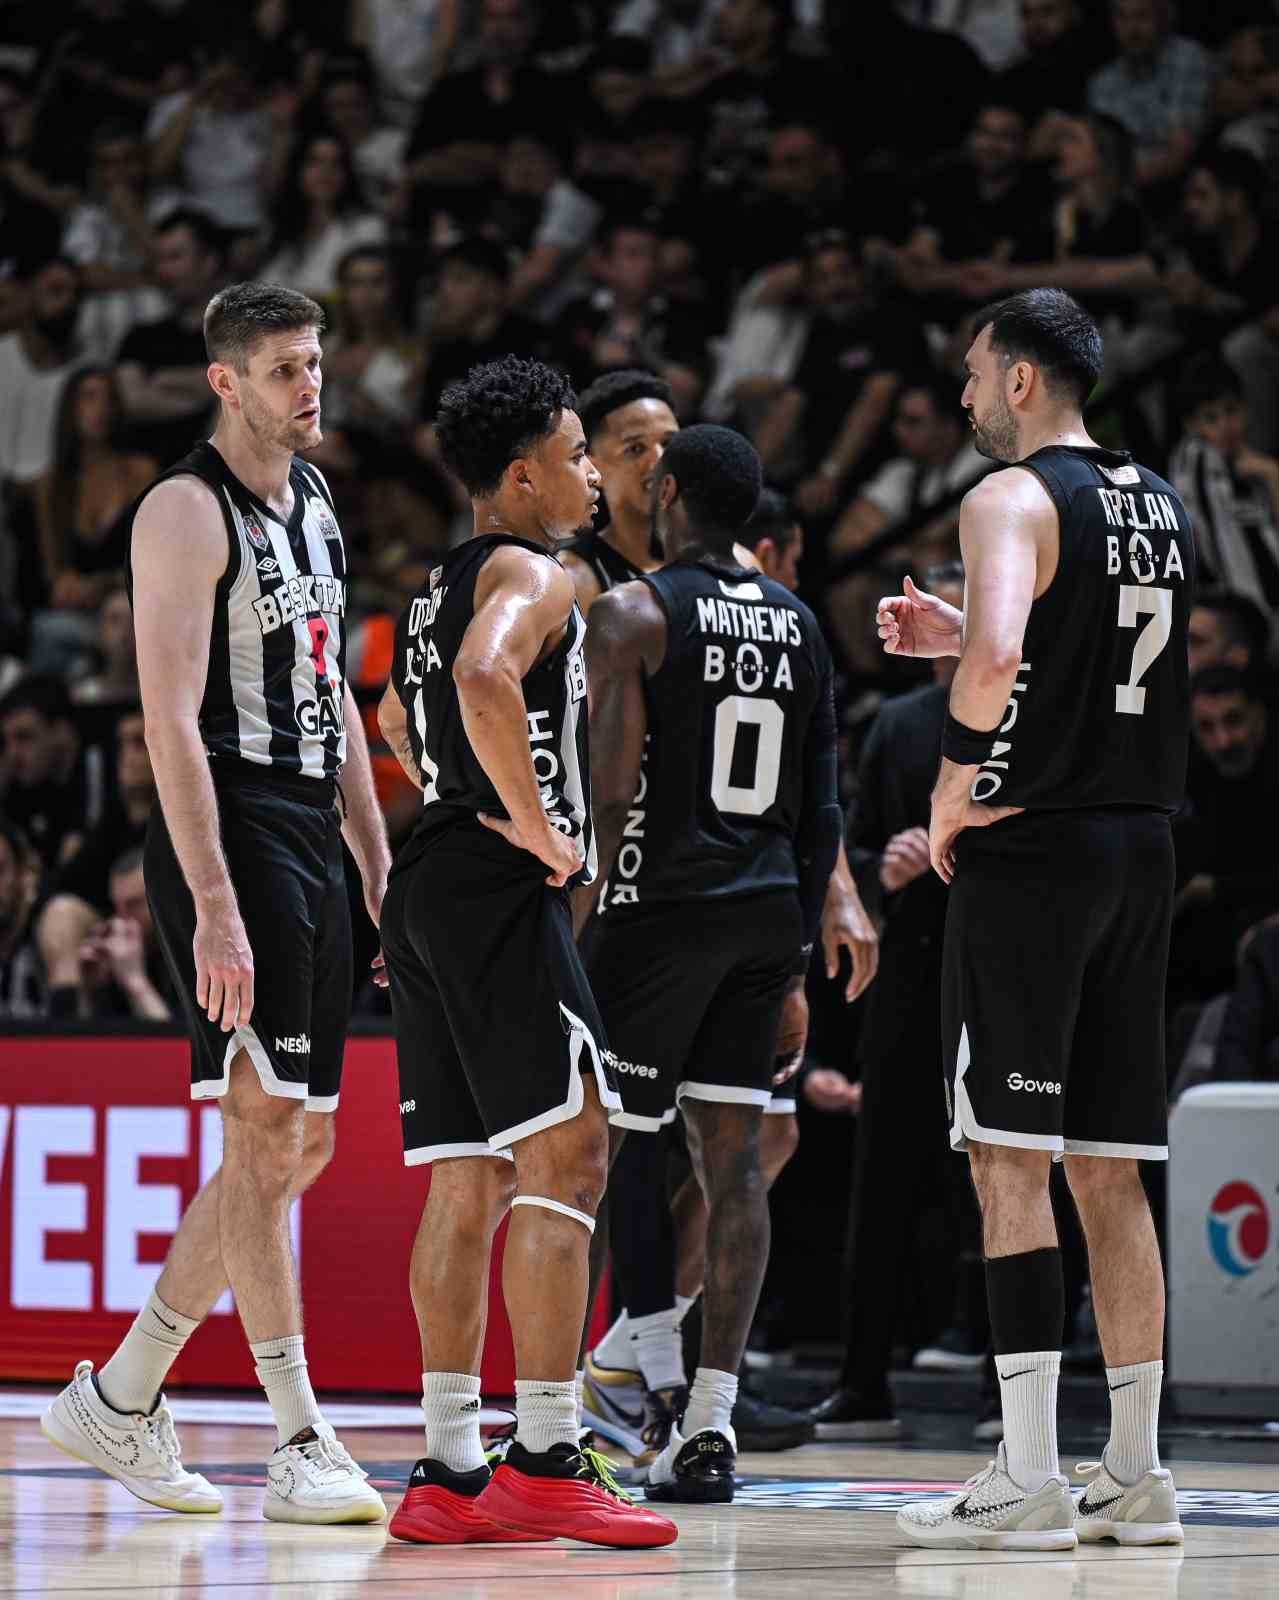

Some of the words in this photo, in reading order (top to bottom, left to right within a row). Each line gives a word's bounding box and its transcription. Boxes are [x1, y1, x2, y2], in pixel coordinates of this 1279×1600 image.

[261, 572, 281, 581] umbro
[696, 598, 802, 647] MATHEWS
[1116, 585, 1174, 715] 7
[711, 695, 785, 816] 0
[1007, 1072, 1062, 1095] Govee
